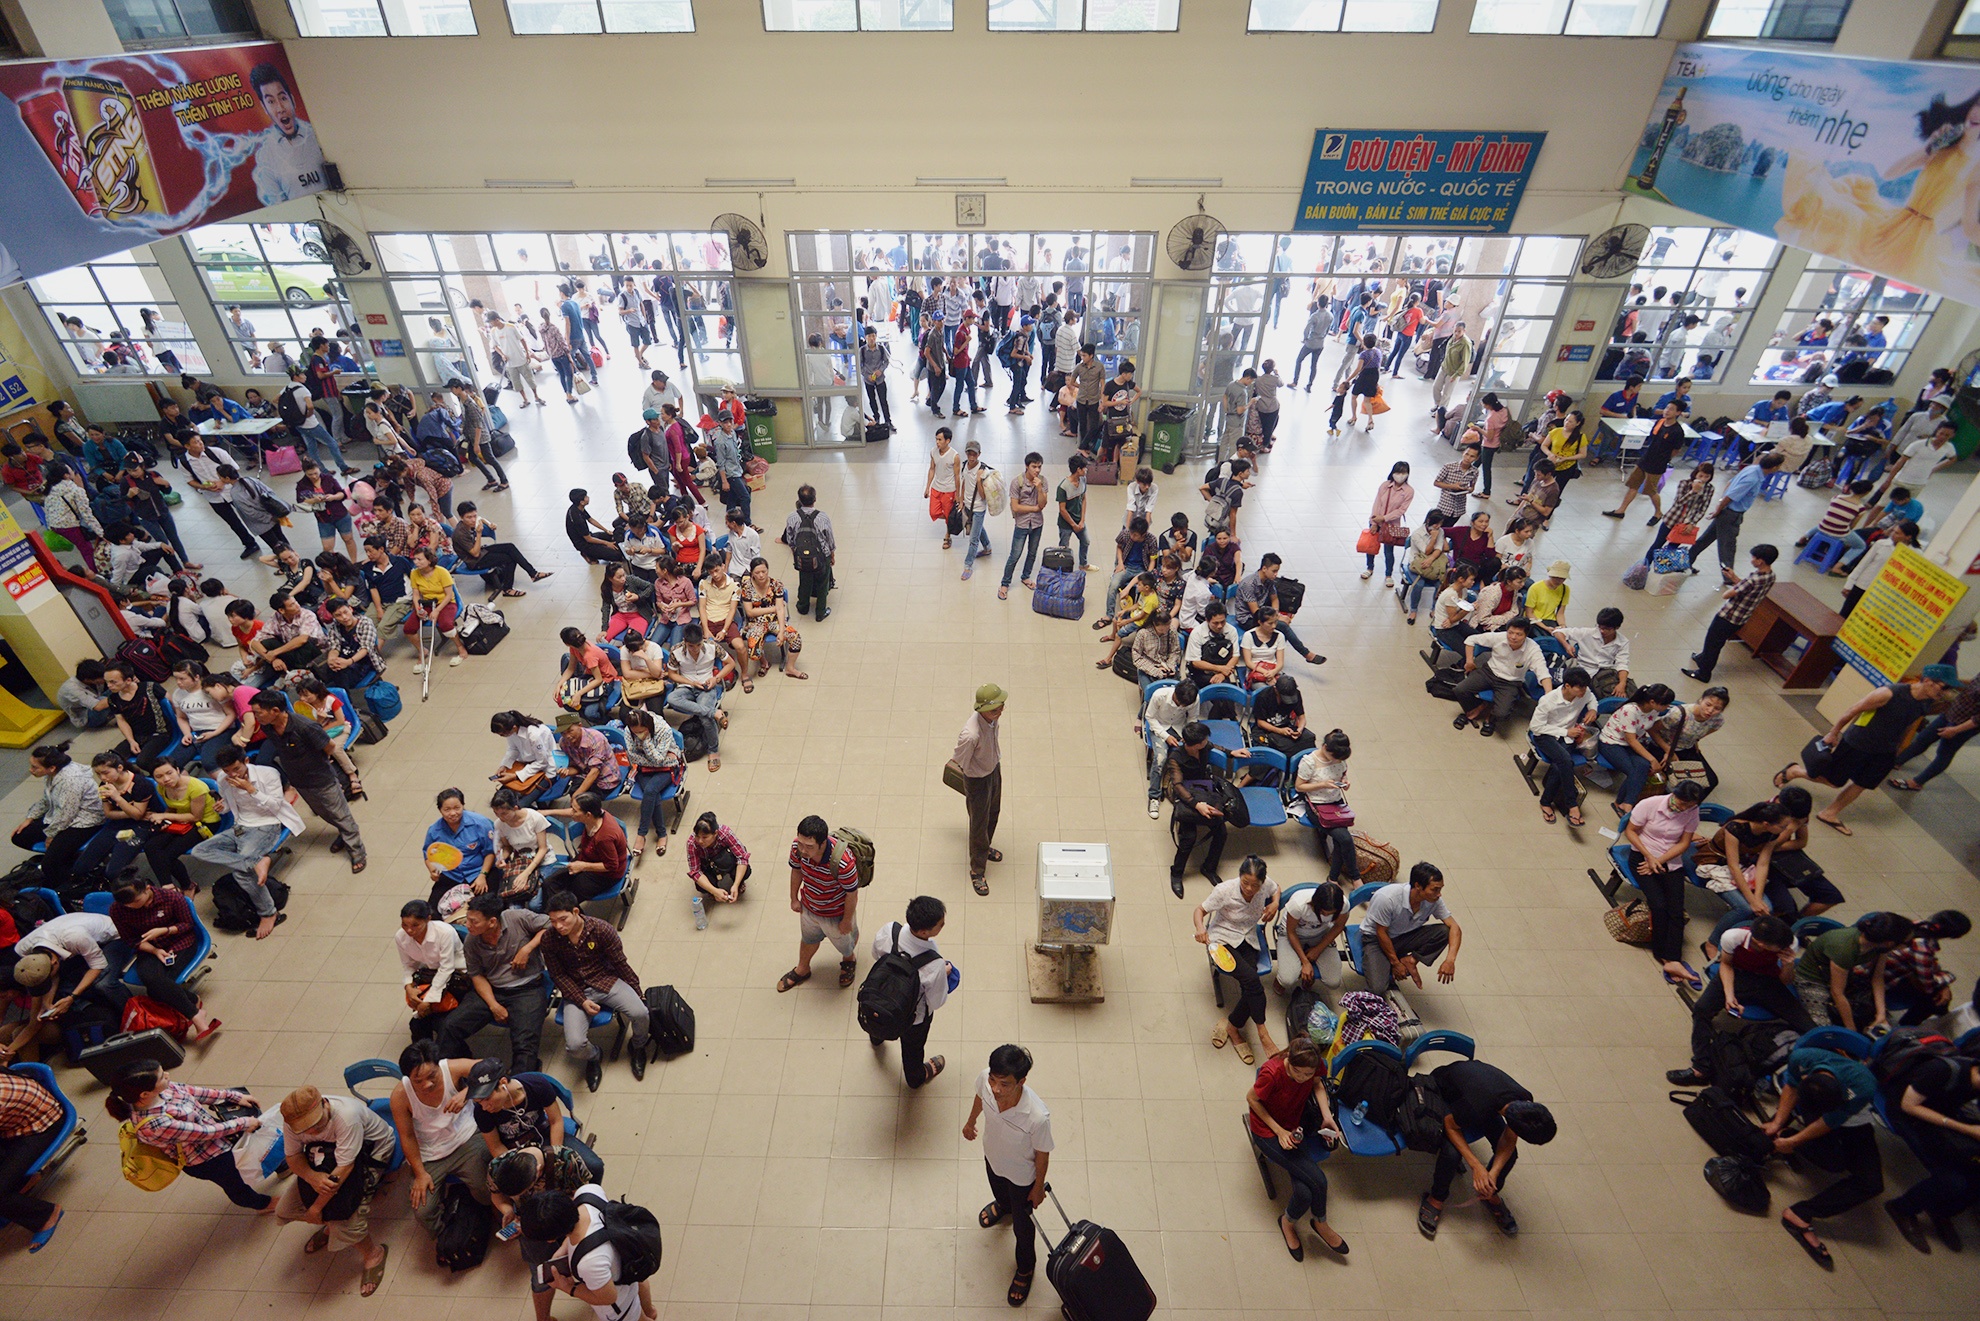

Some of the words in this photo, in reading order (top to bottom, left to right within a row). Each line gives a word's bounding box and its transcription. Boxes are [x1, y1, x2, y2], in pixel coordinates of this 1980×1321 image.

[136, 89, 173, 111] THÊM
[171, 82, 207, 103] NĂNG
[205, 73, 242, 94] LƯỢNG
[1747, 66, 1791, 101] uống
[1789, 80, 1812, 98] cho
[1812, 84, 1846, 107] ngày
[175, 105, 209, 127] THÊM
[1788, 106, 1820, 127] thêm
[1815, 109, 1868, 155] nhẹ
[97, 107, 142, 195] STING
[1345, 137, 1389, 172] BƯU
[1386, 134, 1437, 178] ĐIỆN
[1445, 135, 1484, 172] MỸ
[1478, 135, 1532, 173] ĐÌNH
[298, 170, 320, 187] SAU
[1316, 181, 1374, 195] TRONG
[1377, 178, 1426, 195] NƯỚC
[1440, 177, 1490, 196] QUỐC
[1495, 178, 1520, 197] TẾ
[1305, 203, 1328, 219] BÁN
[1365, 203, 1387, 219] BÁN
[1388, 200, 1405, 220] LẺ
[1406, 206, 1429, 220] SIM
[1429, 201, 1451, 220] THẺ
[1449, 204, 1469, 221] GIÁ
[1469, 206, 1493, 224] CỰC
[1491, 202, 1510, 221] RẺ
[9, 382, 22, 394] 52
